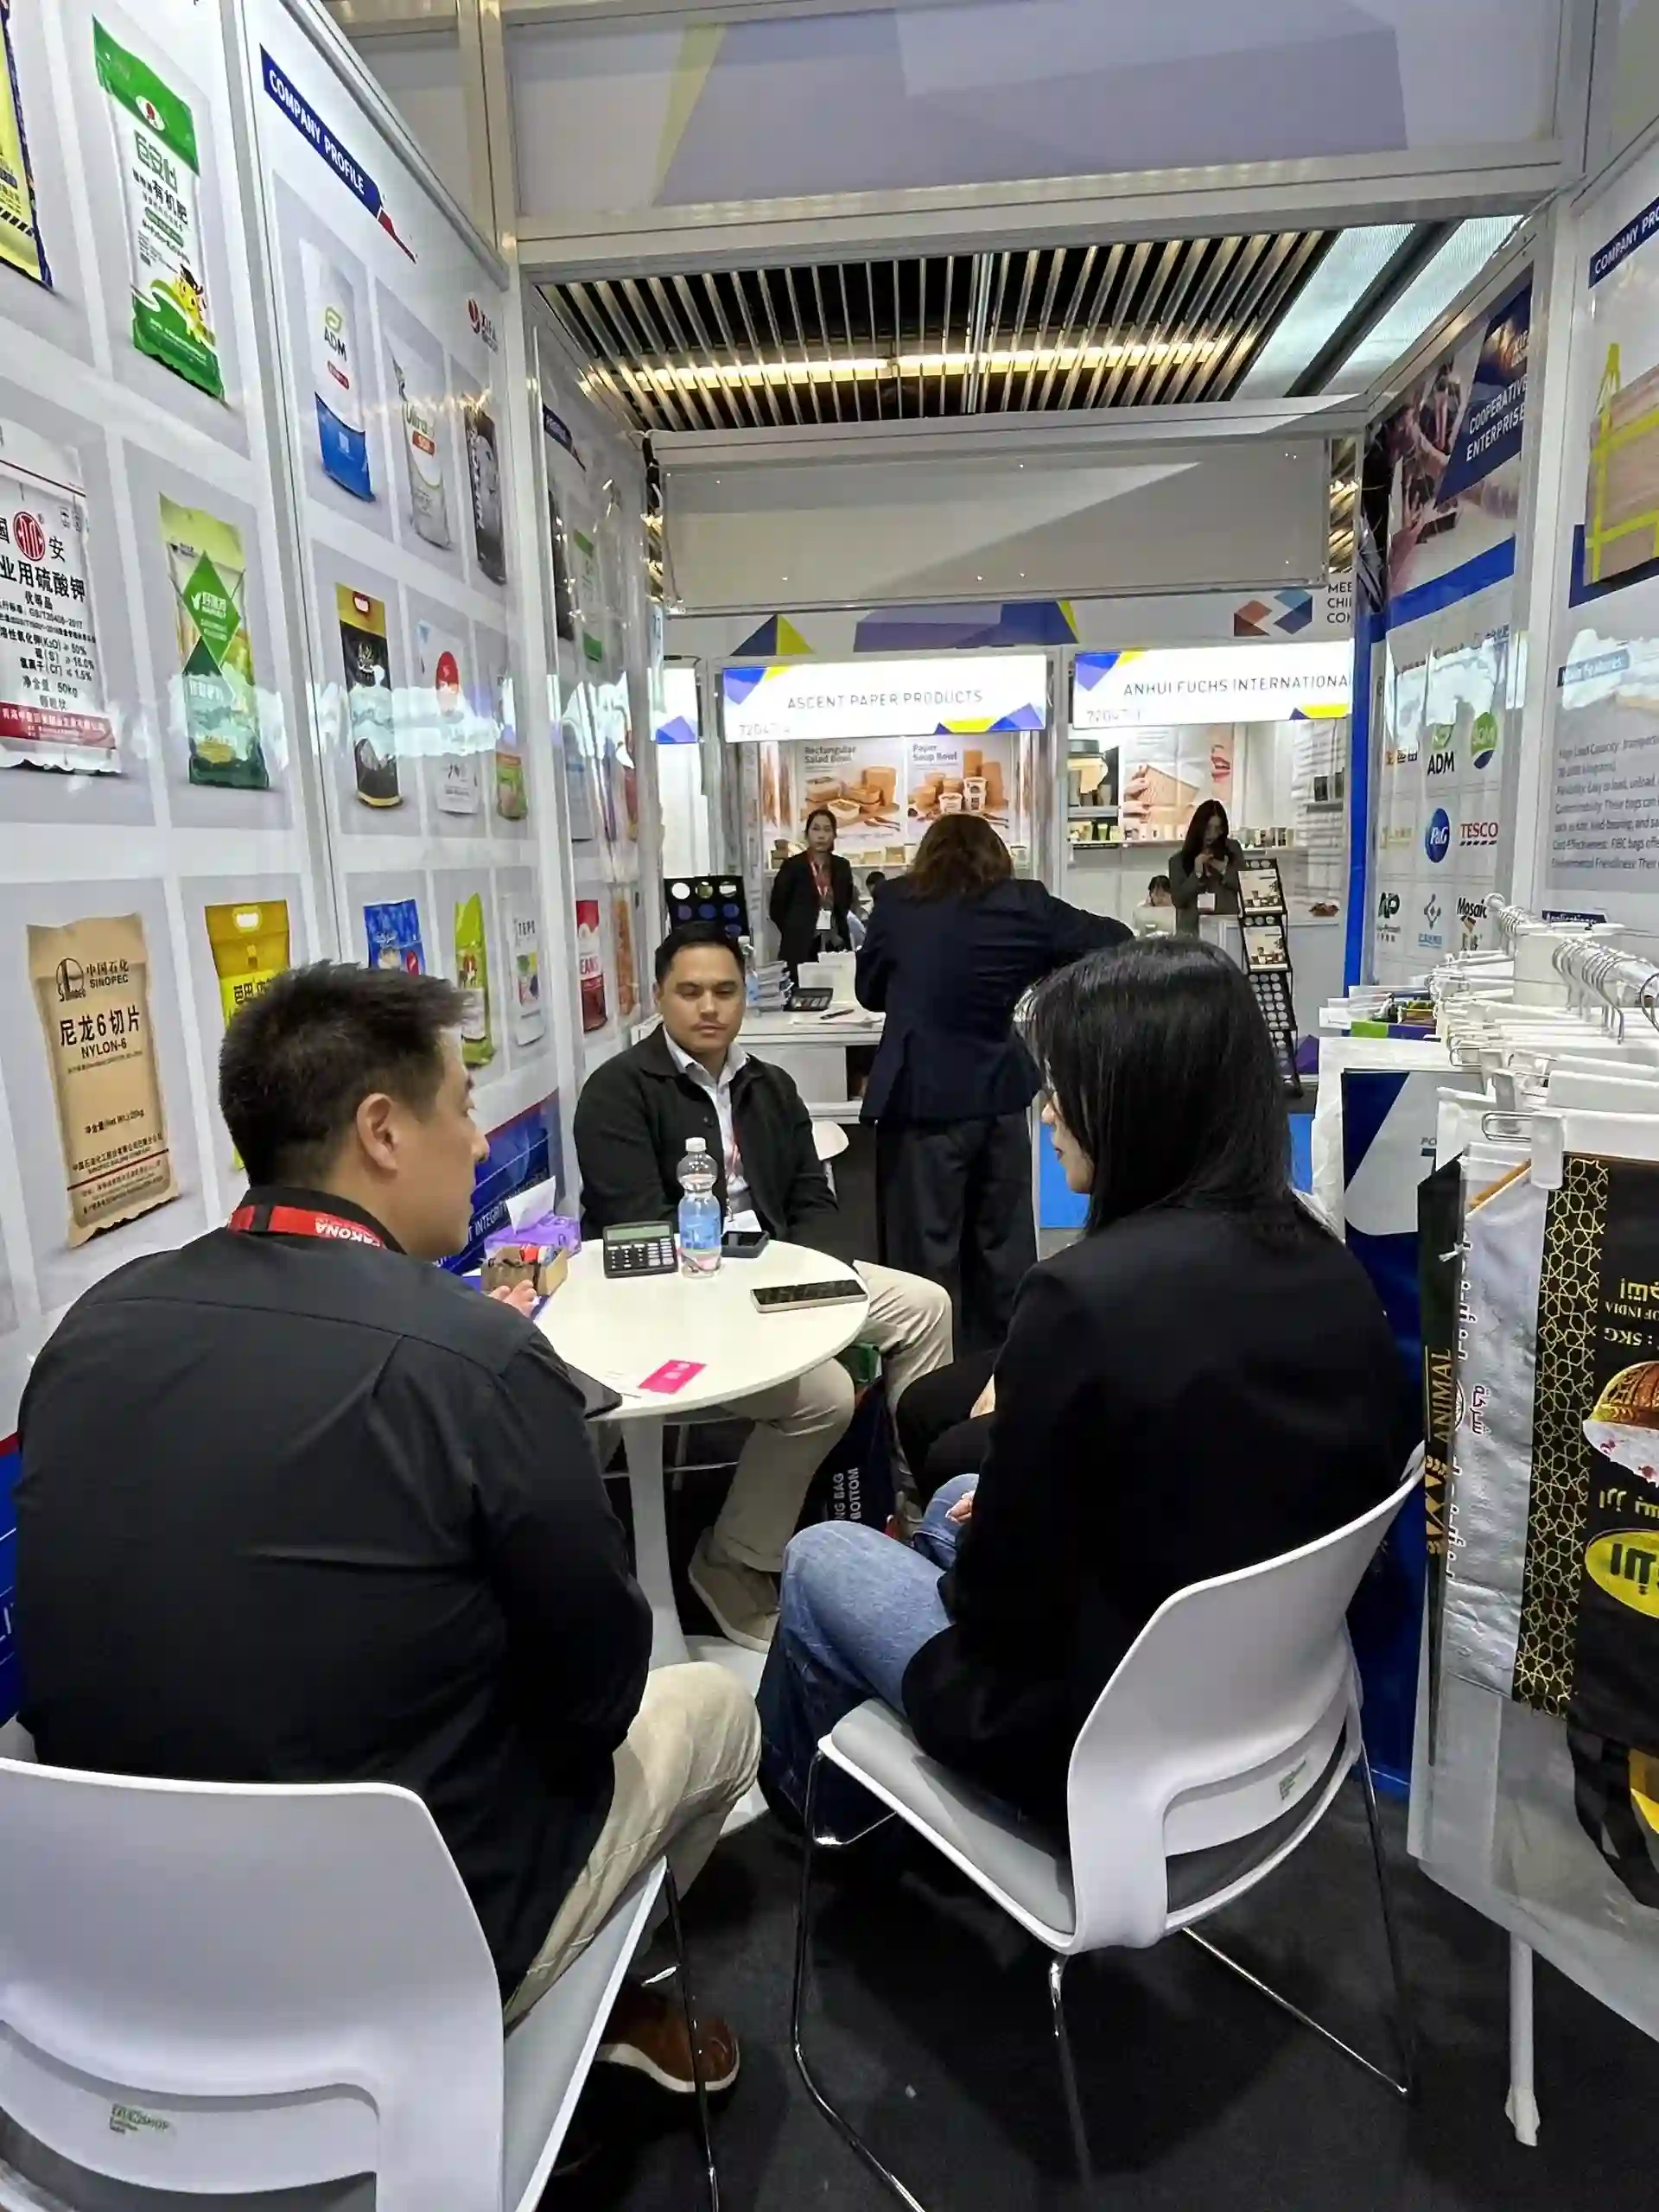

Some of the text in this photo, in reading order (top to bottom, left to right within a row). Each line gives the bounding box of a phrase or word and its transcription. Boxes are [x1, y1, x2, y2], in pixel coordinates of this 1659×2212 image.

[270, 69, 365, 194] COMPANY PROFILE
[1594, 225, 1638, 275] COMPANY
[325, 327, 347, 361] ADM
[1469, 374, 1528, 435] COOPERATIVE
[1466, 402, 1525, 461] ENTERPRISE
[48, 535, 66, 563] 安
[1123, 683, 1171, 696] ANHUI
[1177, 679, 1228, 695] FUCHS
[787, 690, 982, 709] ASCENT PAPER PRODUCTS
[804, 745, 856, 755] Rectangular
[804, 754, 829, 764] Salad
[936, 751, 957, 760] Bowl
[1427, 751, 1455, 776] ADM
[1430, 826, 1448, 845] P&G
[1461, 822, 1498, 838] TESCO
[1457, 897, 1487, 919] Mosaic
[87, 958, 129, 976] 中国石化
[90, 974, 129, 988] SINOPEC
[60, 1005, 140, 1047] 尼龙6切片
[81, 1037, 127, 1059] NYLON-6
[1605, 1301, 1642, 1318] INDIA
[1604, 1327, 1643, 1346] 5KG
[1431, 1348, 1452, 1444] ANIMAL
